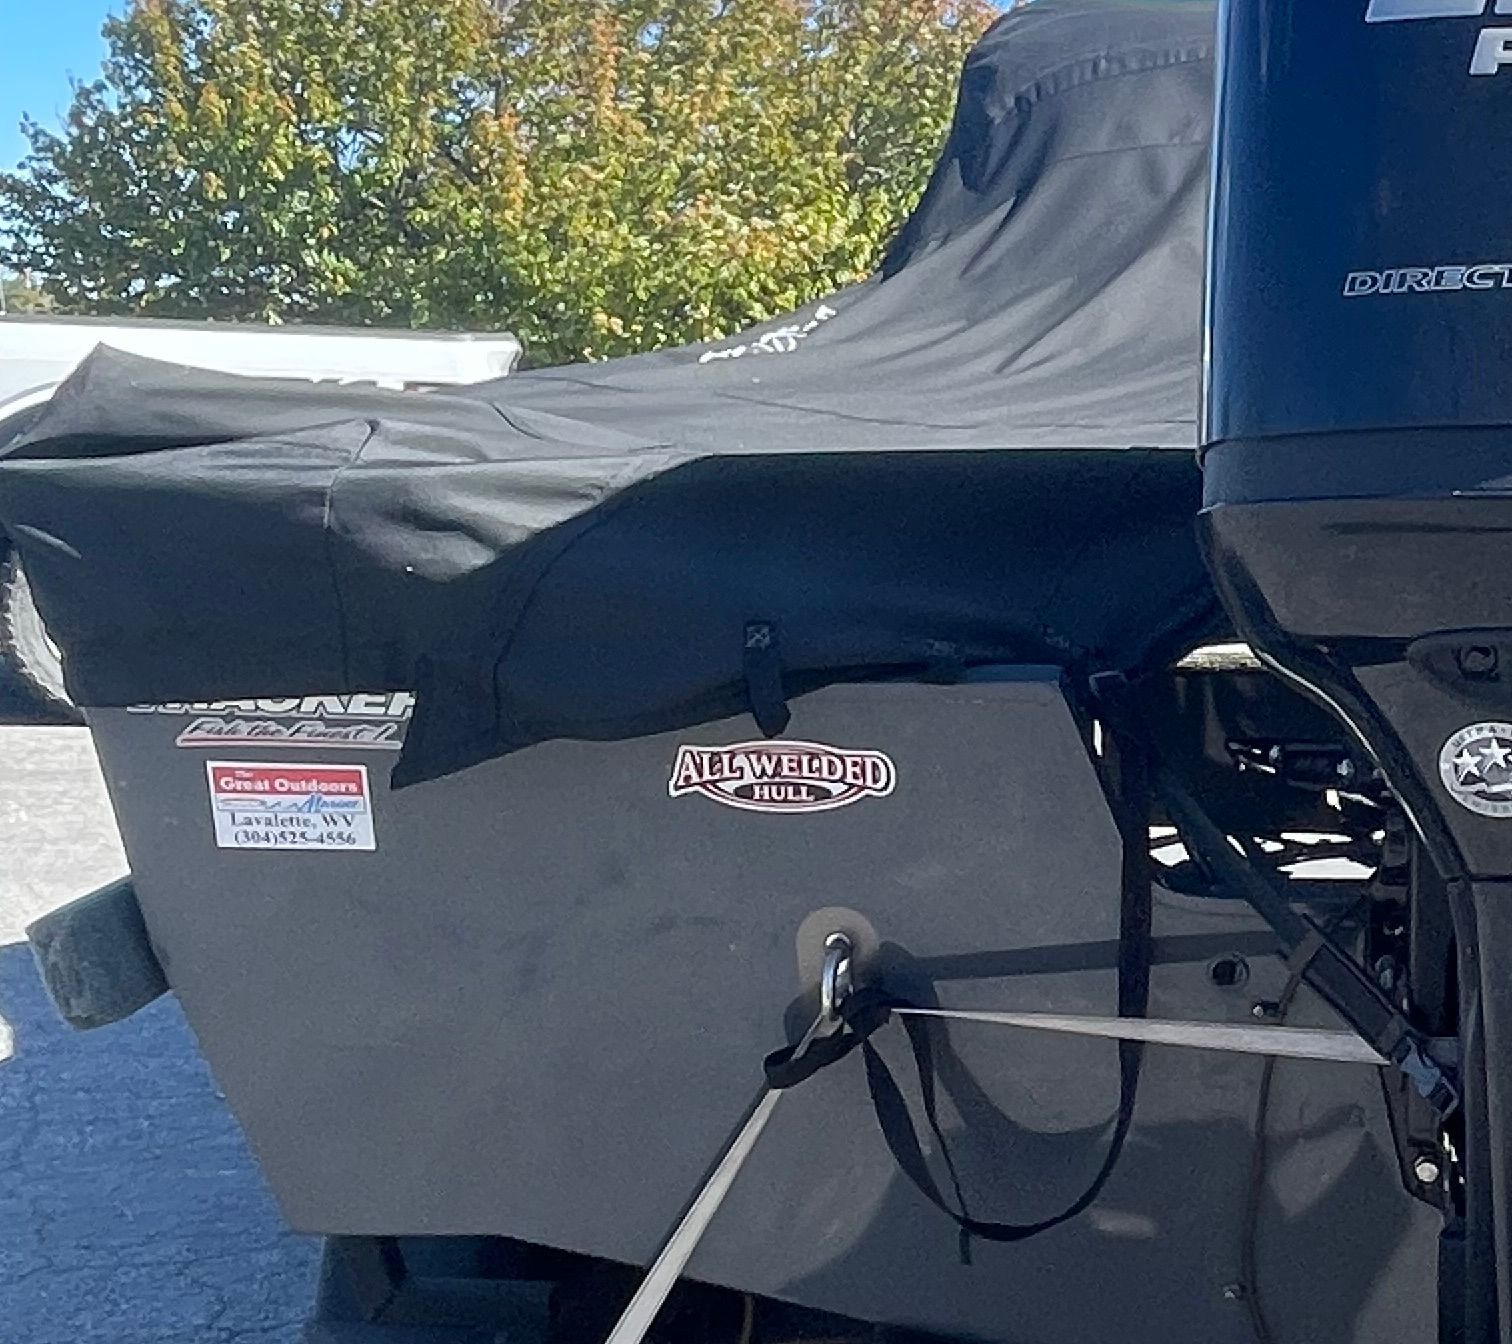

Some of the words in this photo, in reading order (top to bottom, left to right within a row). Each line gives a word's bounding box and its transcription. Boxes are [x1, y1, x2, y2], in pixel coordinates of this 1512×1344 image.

[678, 752, 741, 787] ALL
[749, 754, 888, 791] WELDED
[220, 777, 270, 792] Great
[274, 778, 358, 793] Outdoors
[752, 785, 815, 802] HULL
[230, 812, 318, 830] Lavalette,
[321, 814, 354, 828] WV
